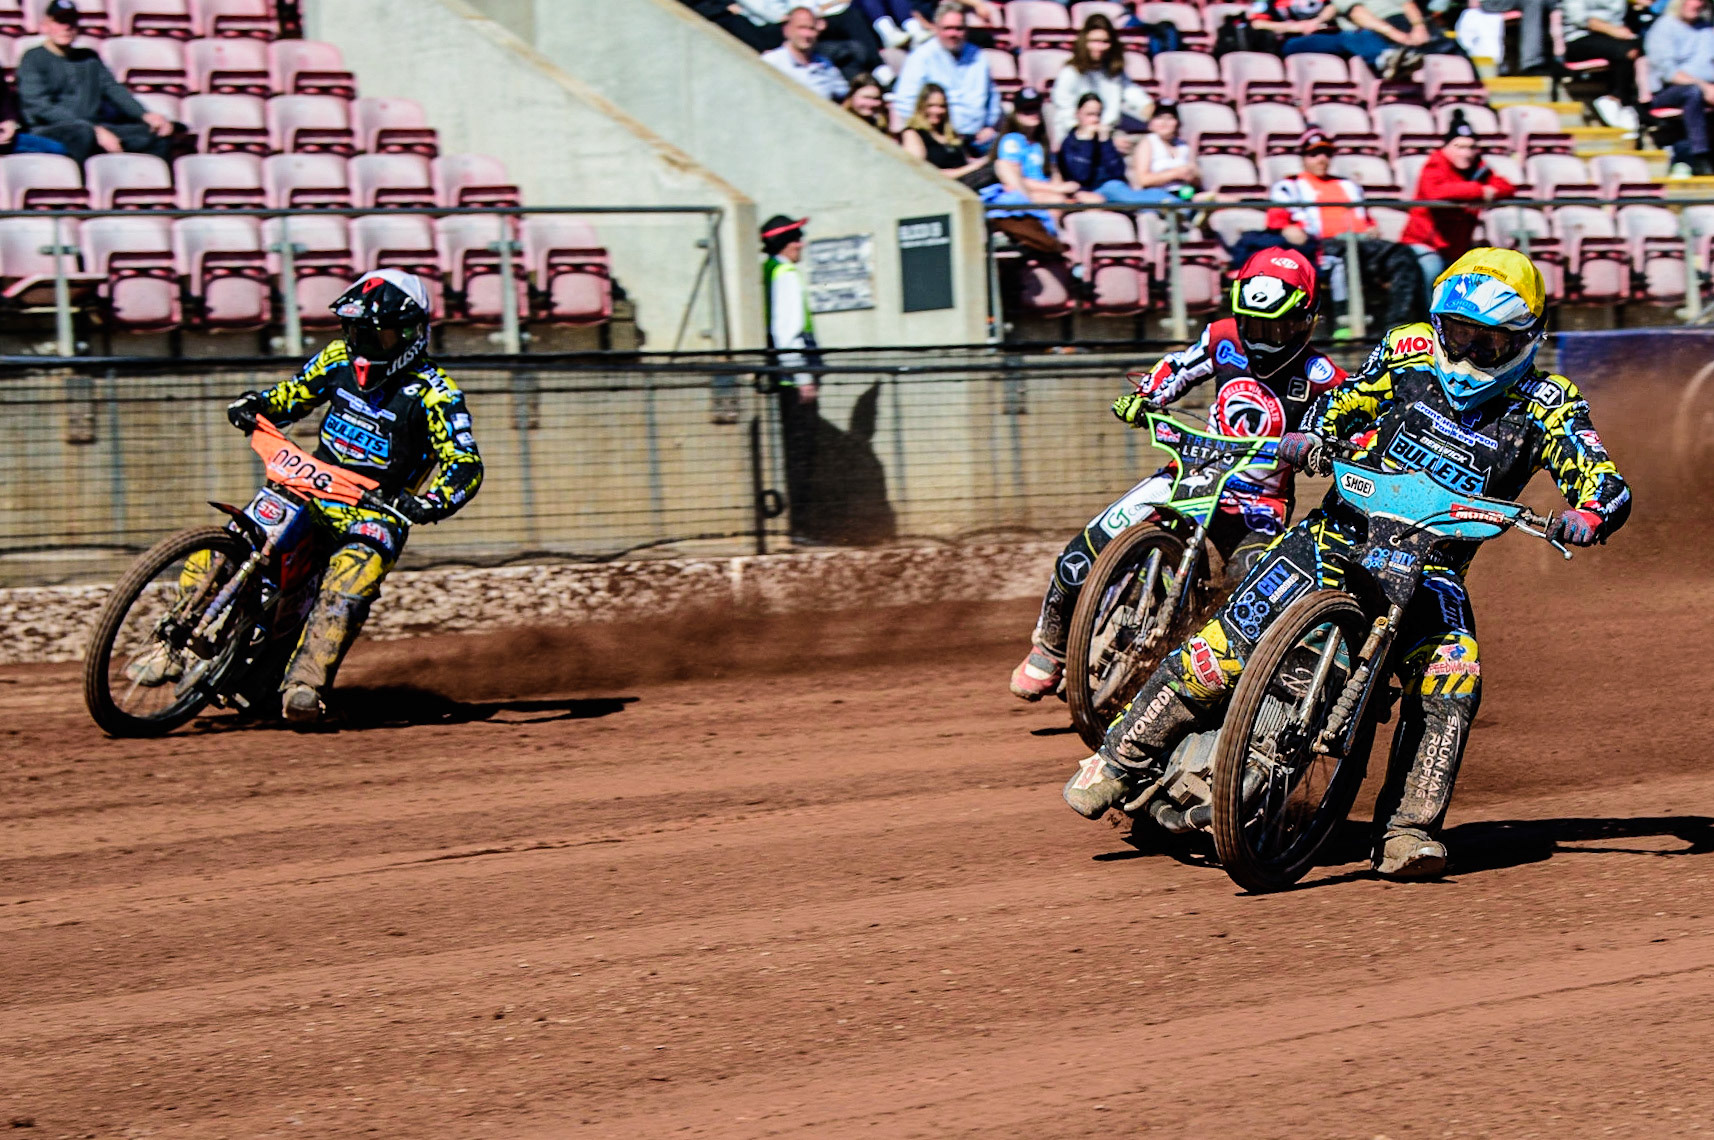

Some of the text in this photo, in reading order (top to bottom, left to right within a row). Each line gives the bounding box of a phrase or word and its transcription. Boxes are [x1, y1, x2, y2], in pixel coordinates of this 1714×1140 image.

[1186, 434, 1239, 451] TRENT
[1420, 436, 1468, 463] BERWICK
[1391, 440, 1479, 493] BULLETS
[1345, 476, 1372, 495] SHOEI
[1257, 563, 1290, 597] CITY
[1434, 715, 1458, 769] SHAUN
[1415, 732, 1441, 799] ROOFING
